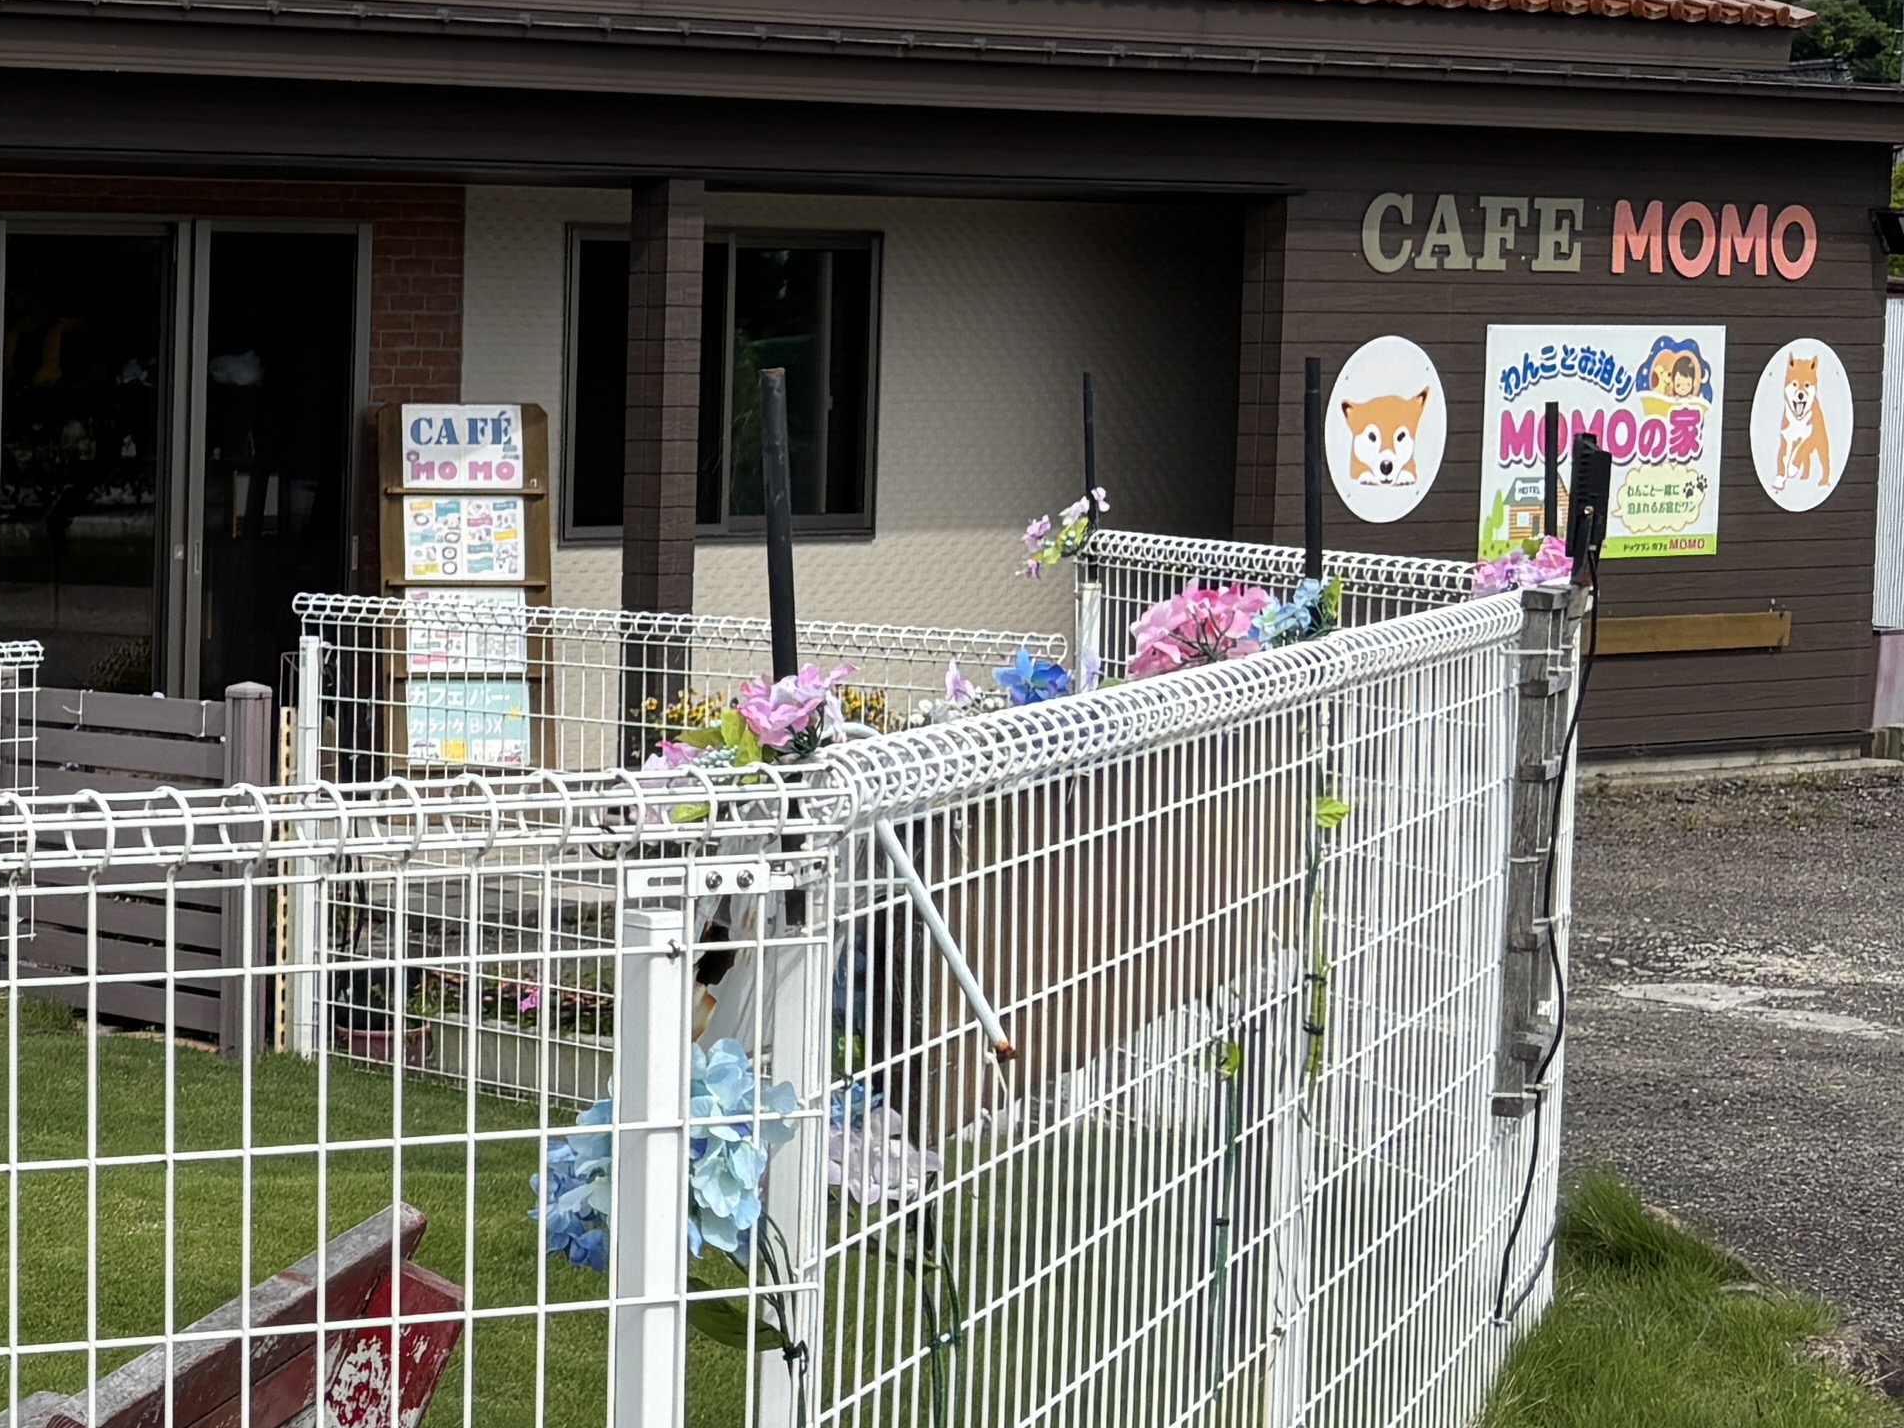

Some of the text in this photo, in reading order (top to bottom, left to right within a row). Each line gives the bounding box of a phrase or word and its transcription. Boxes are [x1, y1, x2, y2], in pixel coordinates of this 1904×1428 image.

[1361, 192, 1818, 280] CAFE MOMO
[1500, 343, 1632, 397] わんことお泊り
